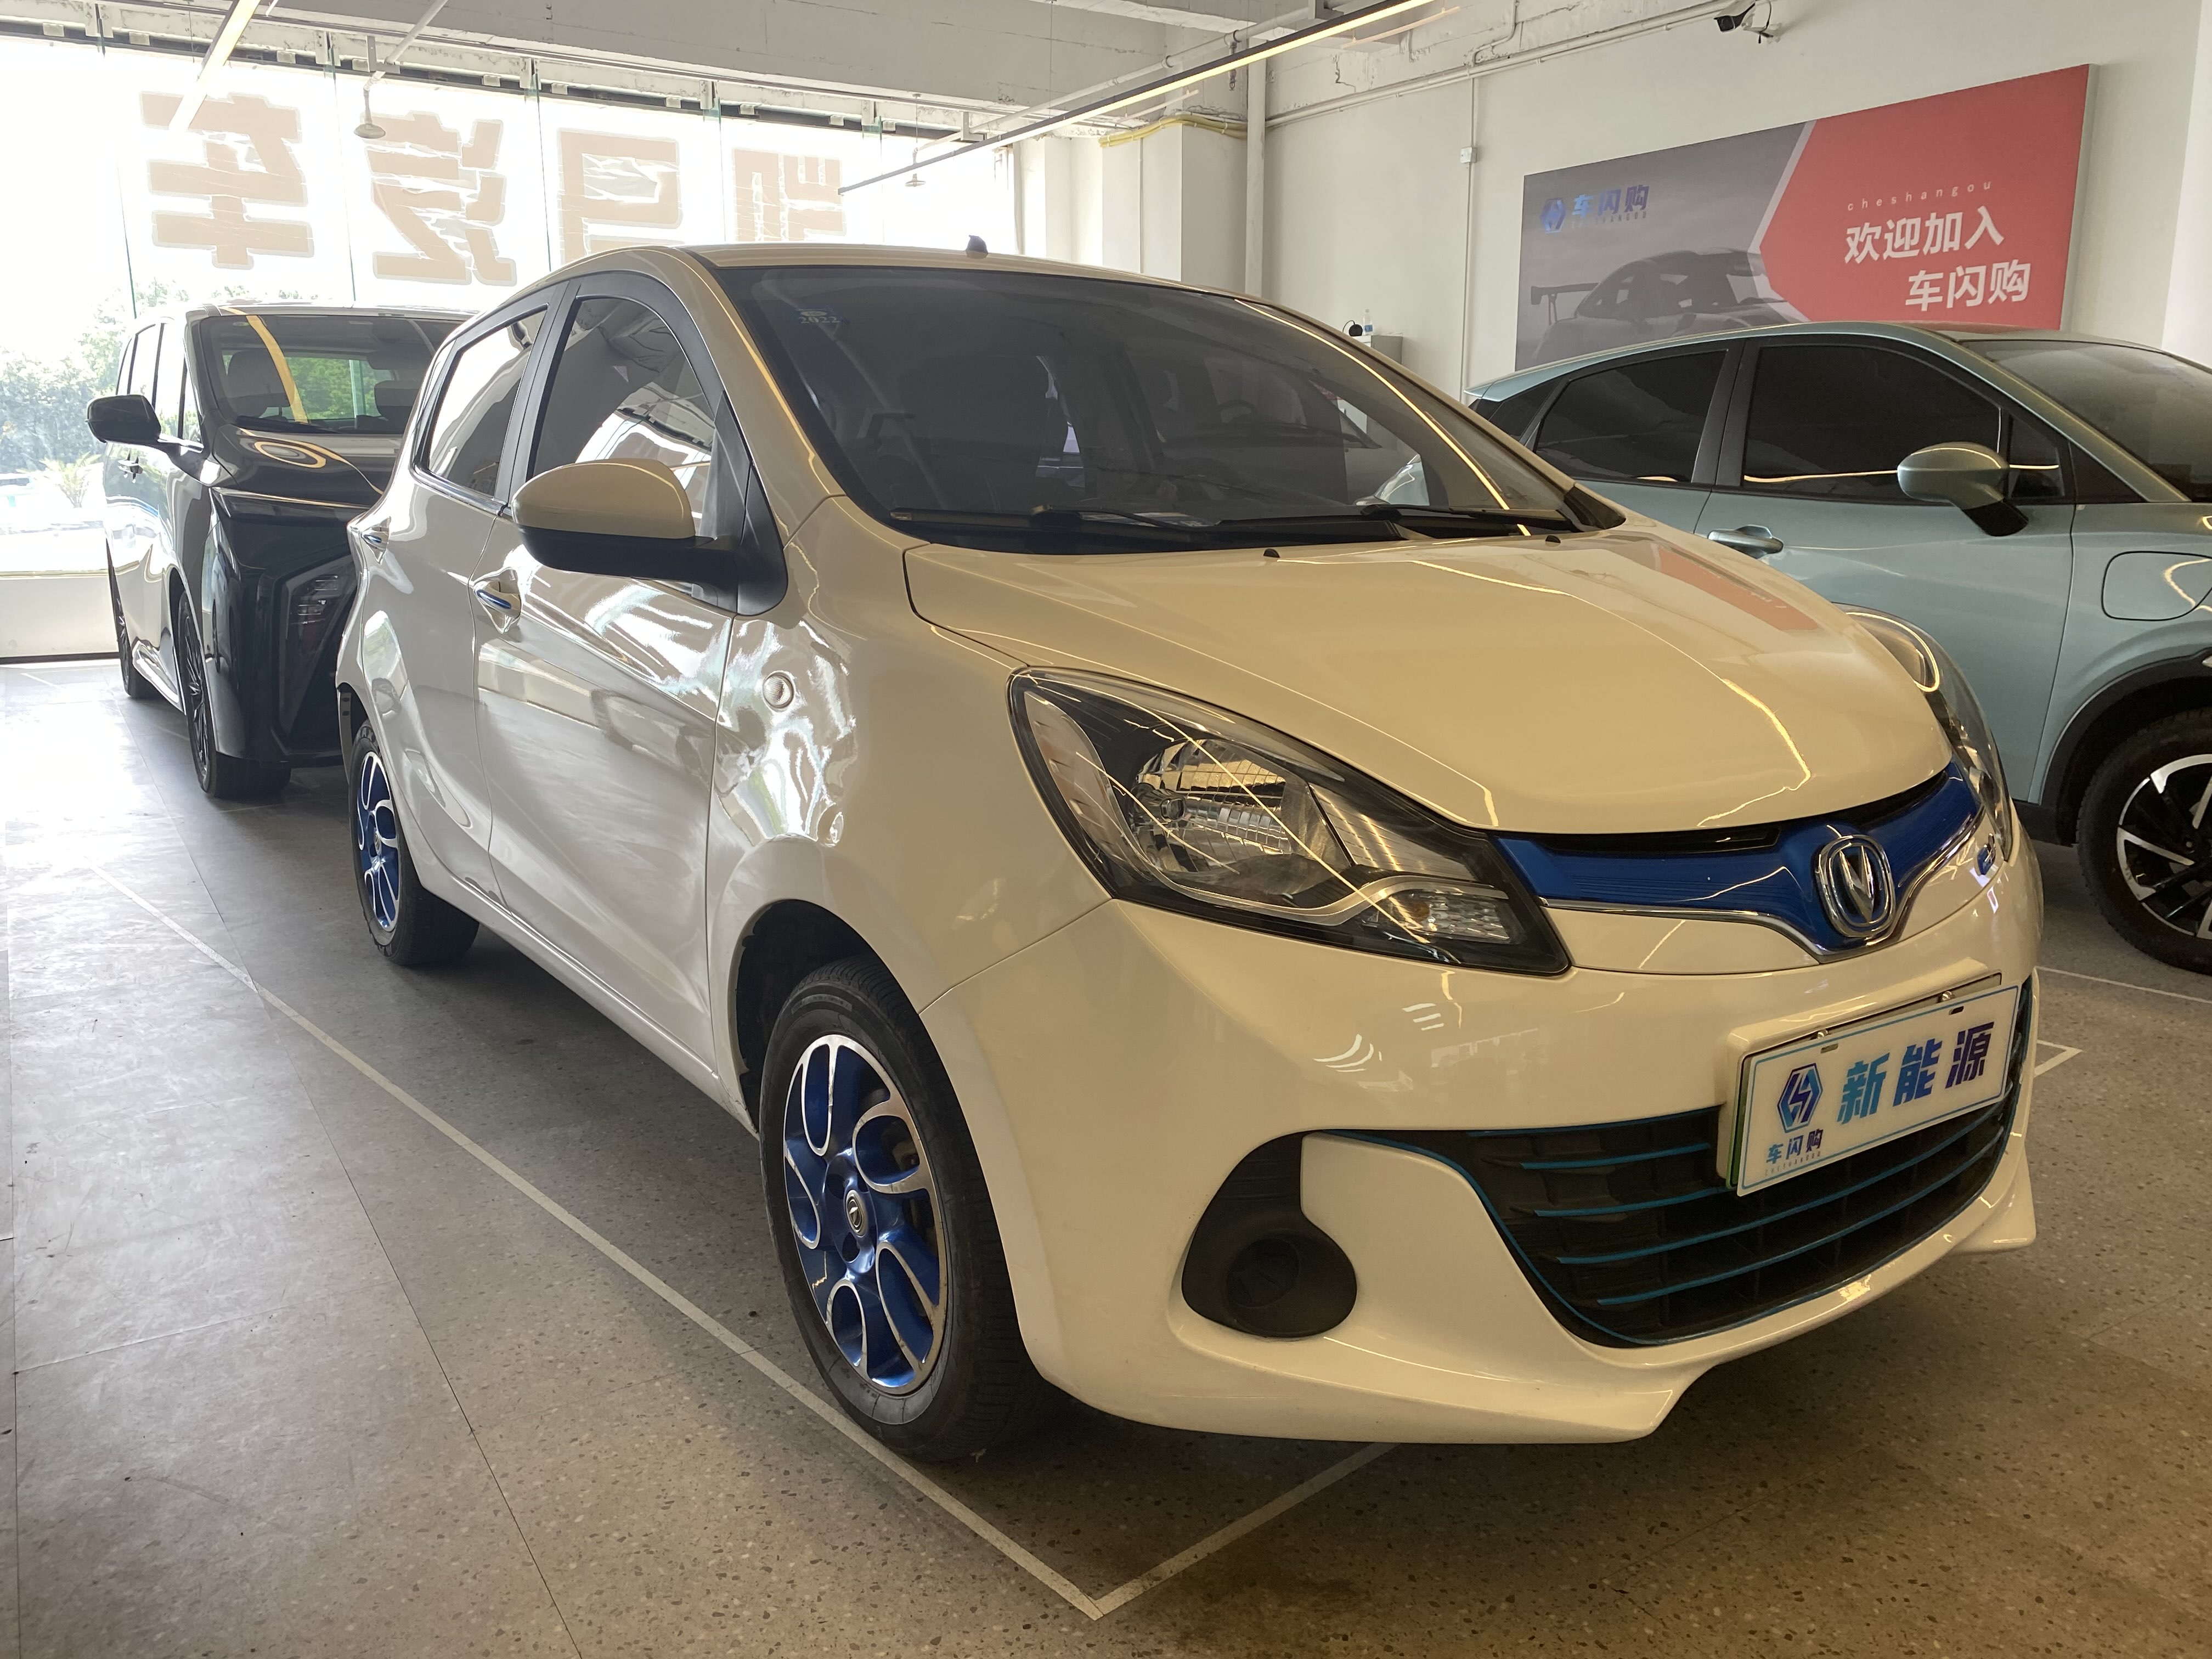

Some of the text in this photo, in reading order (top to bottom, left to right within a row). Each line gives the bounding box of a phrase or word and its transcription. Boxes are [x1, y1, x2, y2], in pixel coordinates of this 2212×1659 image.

[1571, 184, 1650, 218] 车闪购
[1847, 180, 1992, 211] cheshangou
[1844, 205, 2005, 264] 欢迎加入
[1905, 259, 2032, 312] 车闪购
[798, 316, 840, 324] 2022
[1836, 1022, 1995, 1125] 新能源
[1765, 1128, 1824, 1164] 车闪购
